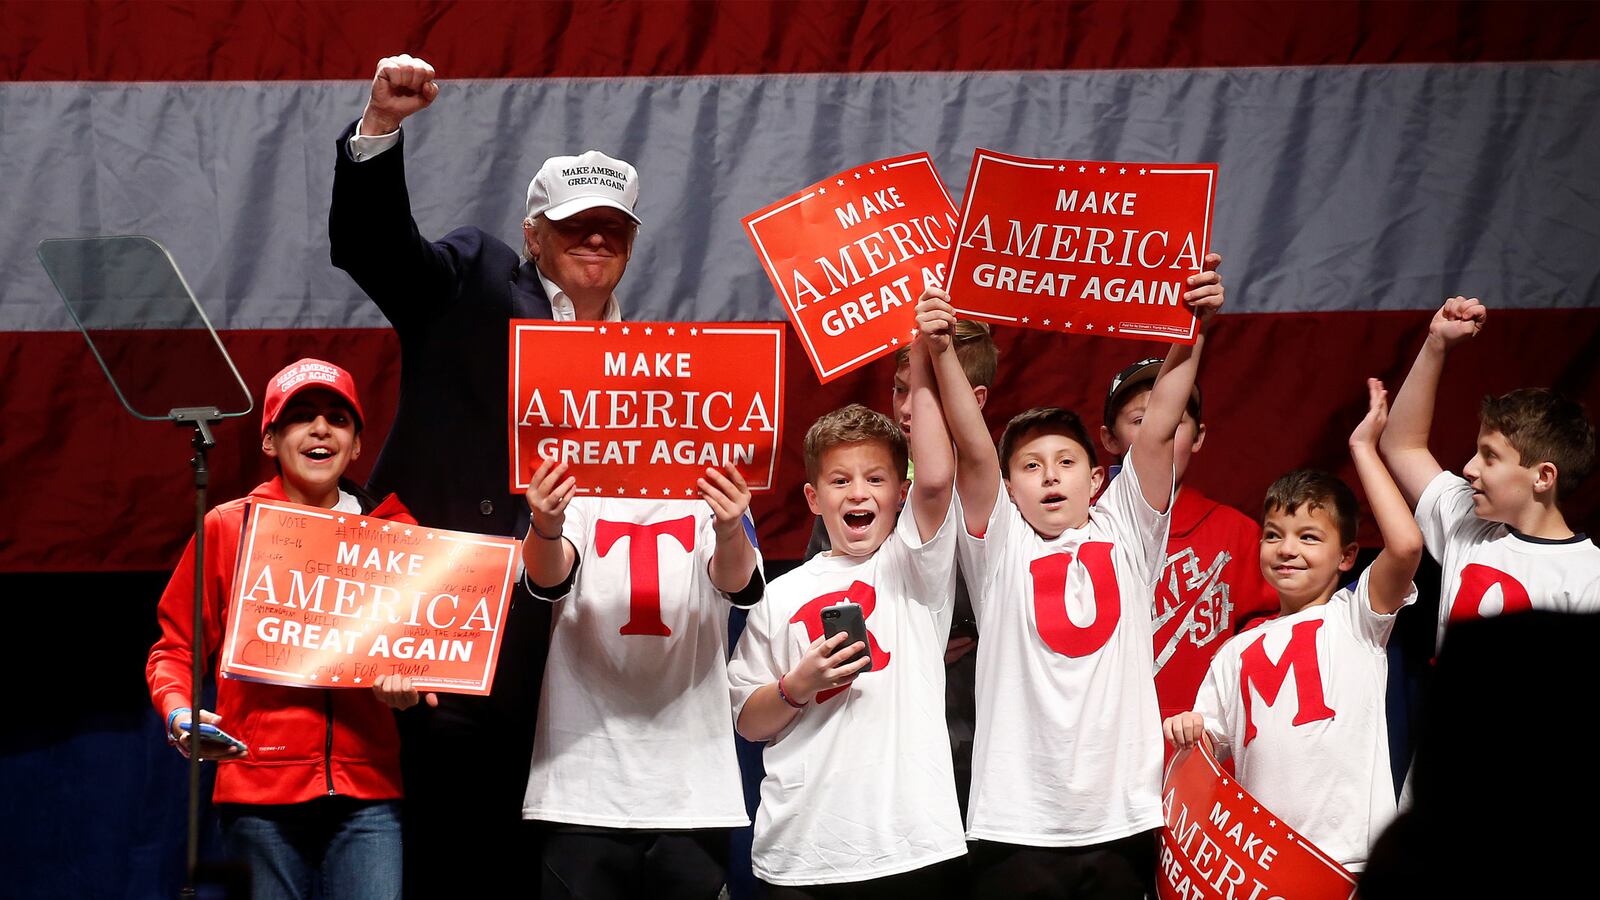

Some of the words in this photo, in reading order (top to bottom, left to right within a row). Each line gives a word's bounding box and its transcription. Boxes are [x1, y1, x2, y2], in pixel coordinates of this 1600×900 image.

[562, 167, 589, 177] MAKE
[591, 167, 628, 182] AMERICA
[568, 178, 598, 187] GREAT
[600, 177, 625, 191] AGAIN
[834, 187, 905, 229] MAKE
[1055, 189, 1137, 216] MAKE
[961, 214, 1201, 271] AMERICA
[972, 264, 1076, 298] GREAT
[1080, 277, 1181, 306] AGAIN
[821, 276, 913, 337] GREAT
[604, 352, 691, 378] MAKE
[519, 388, 774, 431] AMERICA
[537, 438, 641, 464] GREAT
[650, 440, 754, 467] AGAIN
[279, 515, 307, 528] VOTE
[305, 560, 332, 574] GET
[337, 566, 357, 577] RID
[365, 570, 378, 580] OF
[336, 541, 424, 577] MAKE
[595, 515, 695, 636] T
[243, 565, 495, 631] AMERICA
[1030, 541, 1120, 658] U
[257, 617, 362, 656] GREAT
[368, 632, 474, 662] AGAIN
[434, 629, 449, 637] THE
[354, 662, 378, 677] FOR
[390, 662, 430, 676] TRUMP
[1240, 618, 1336, 747] M
[1162, 787, 1286, 900] AMERI
[1208, 801, 1278, 871] MAKE
